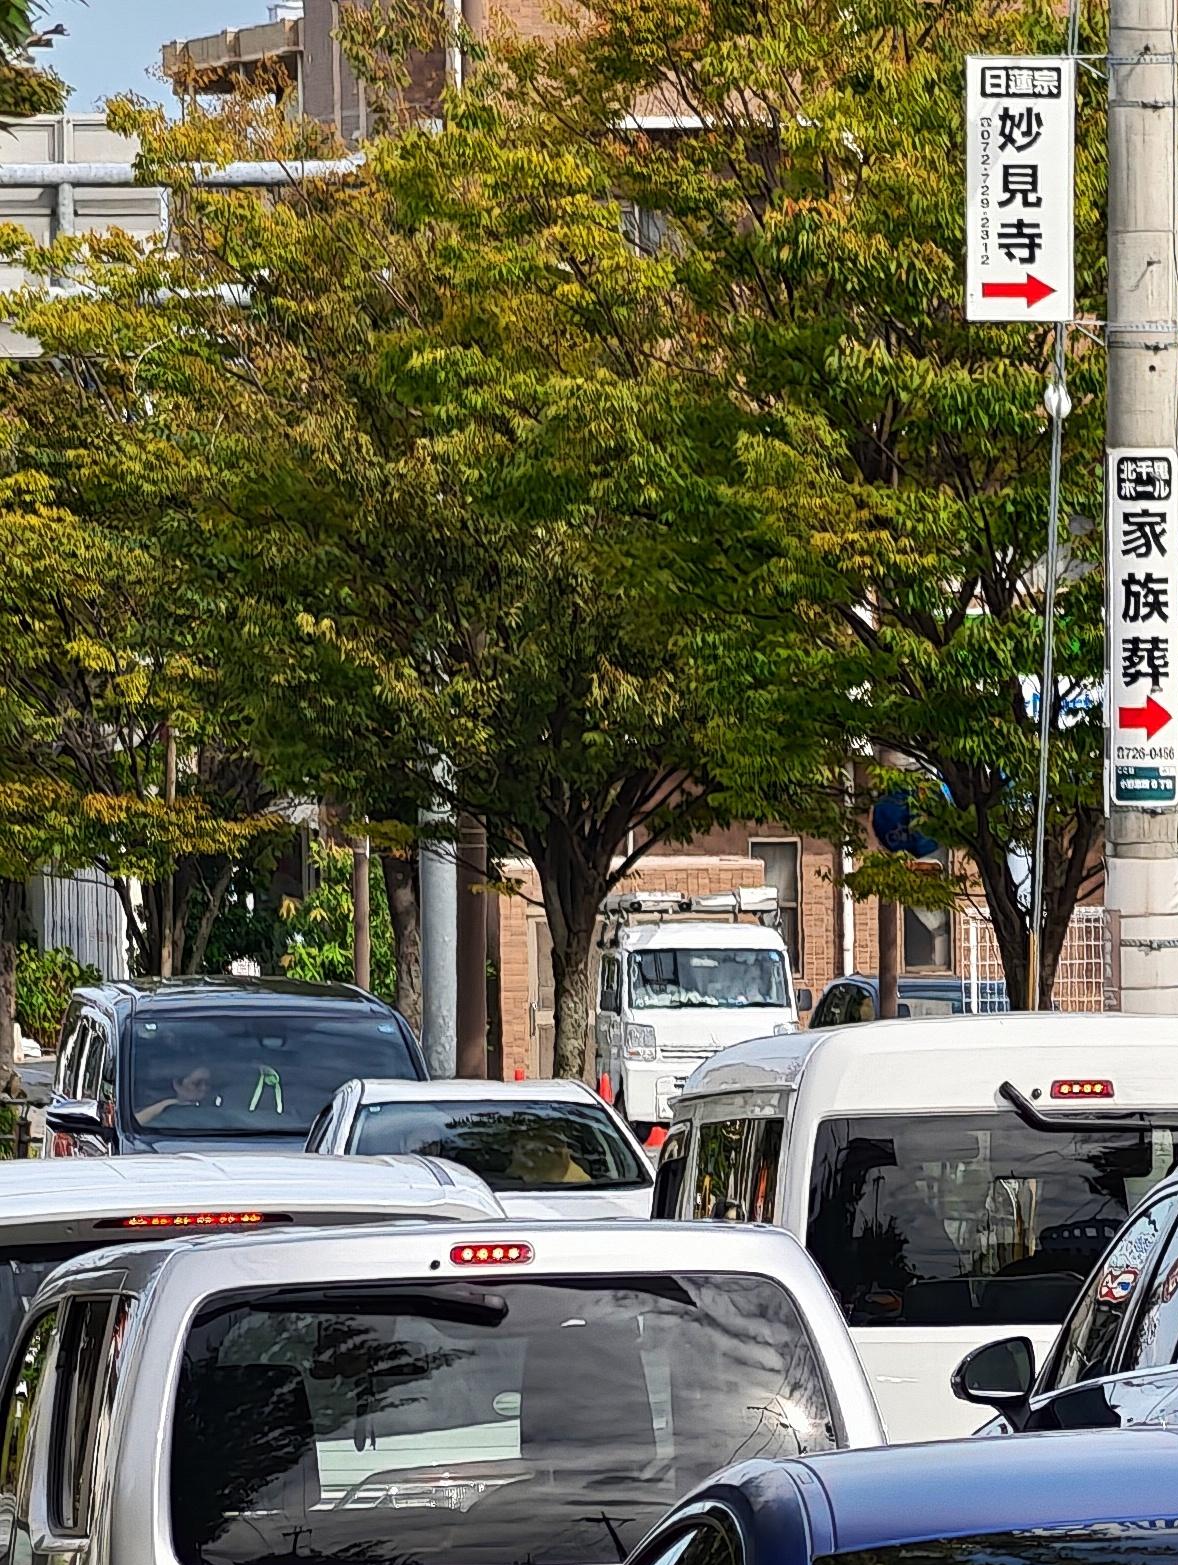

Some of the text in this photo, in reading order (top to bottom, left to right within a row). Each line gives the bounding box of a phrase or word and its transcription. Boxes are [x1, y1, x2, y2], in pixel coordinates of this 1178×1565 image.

[984, 68, 1059, 95] 日蓮宗
[997, 106, 1044, 265] 妙見寺
[1119, 481, 1170, 499] ホール
[1121, 508, 1170, 692] 家族葬
